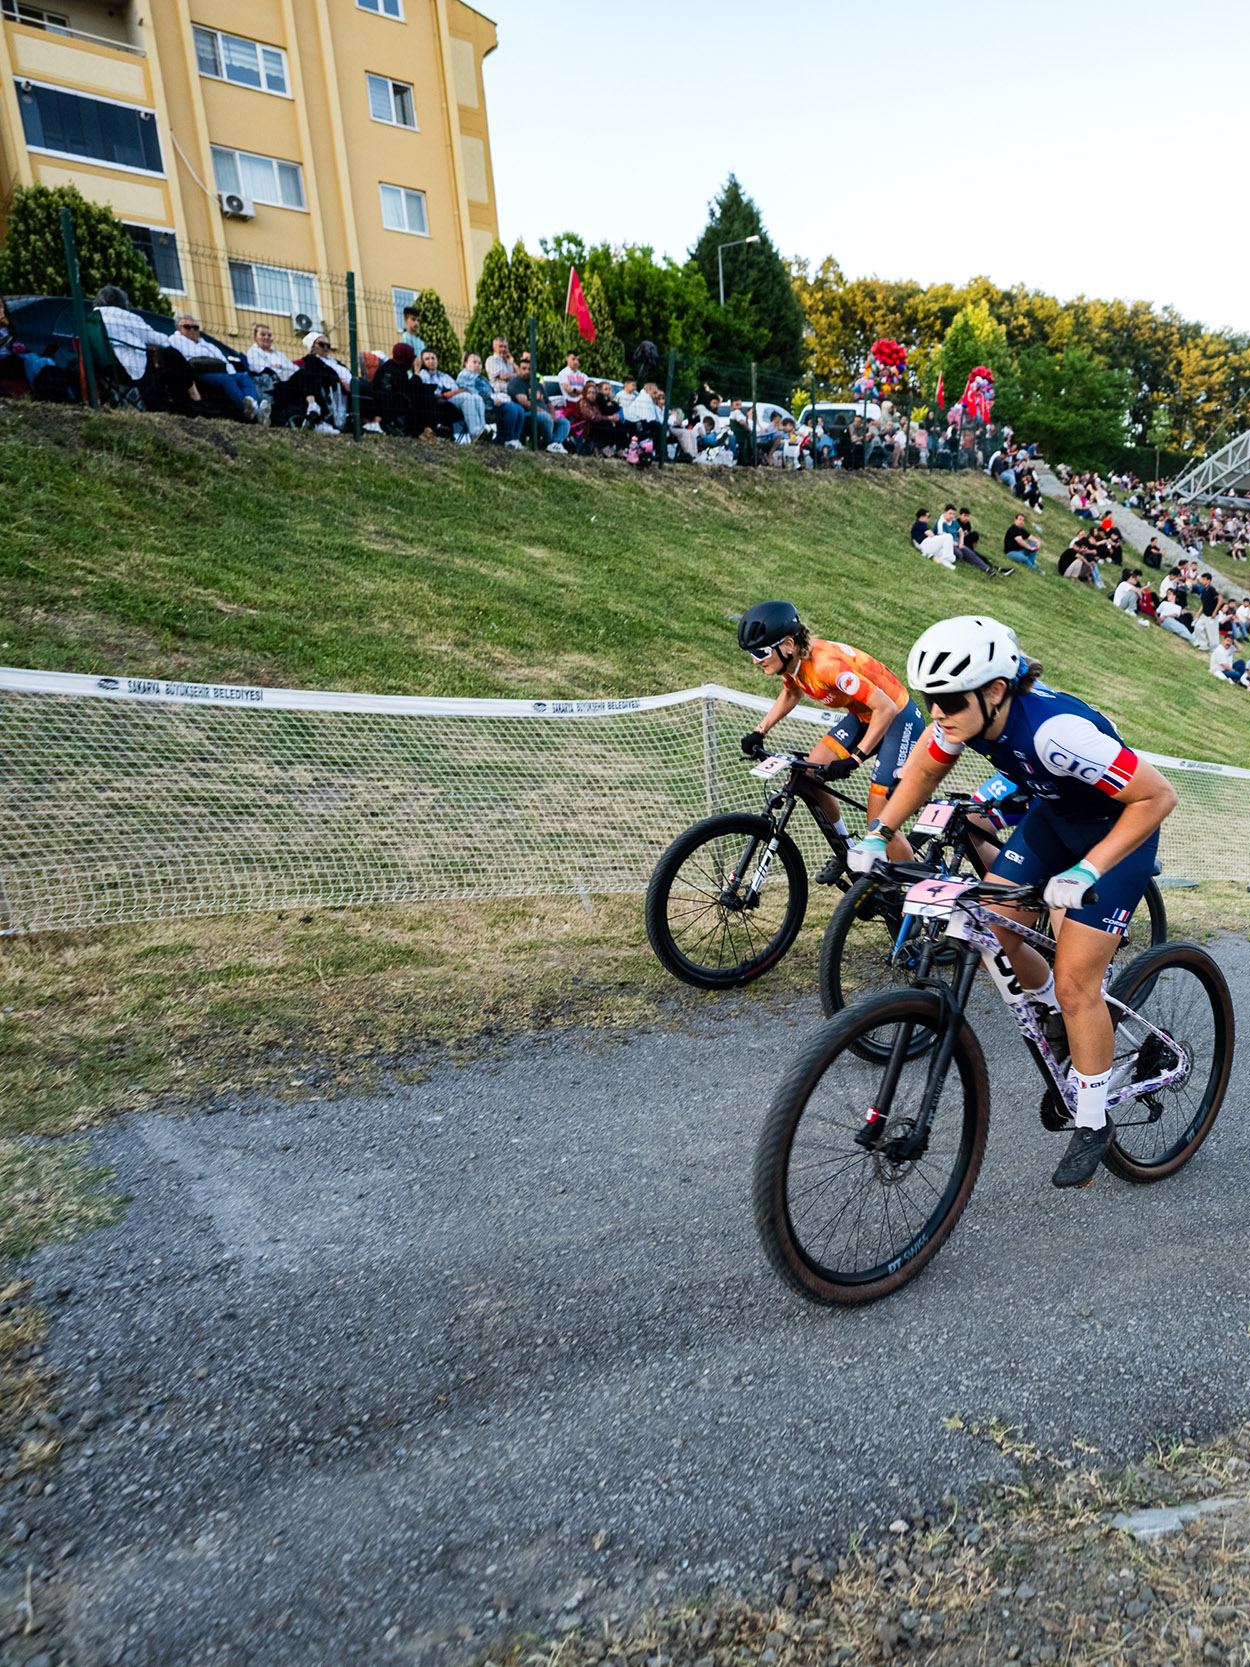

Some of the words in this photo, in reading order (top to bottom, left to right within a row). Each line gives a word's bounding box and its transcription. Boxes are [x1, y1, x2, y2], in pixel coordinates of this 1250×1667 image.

[127, 680, 160, 694] SAKARYA
[213, 688, 263, 701] BELEDİYESİ
[896, 722, 914, 767] NEDERLANDSE
[765, 761, 778, 770] 5
[1049, 752, 1098, 780] CIC
[931, 809, 940, 823] 1
[926, 884, 948, 898] 4
[888, 1257, 902, 1274] DT
[903, 1232, 929, 1261] SWISS
